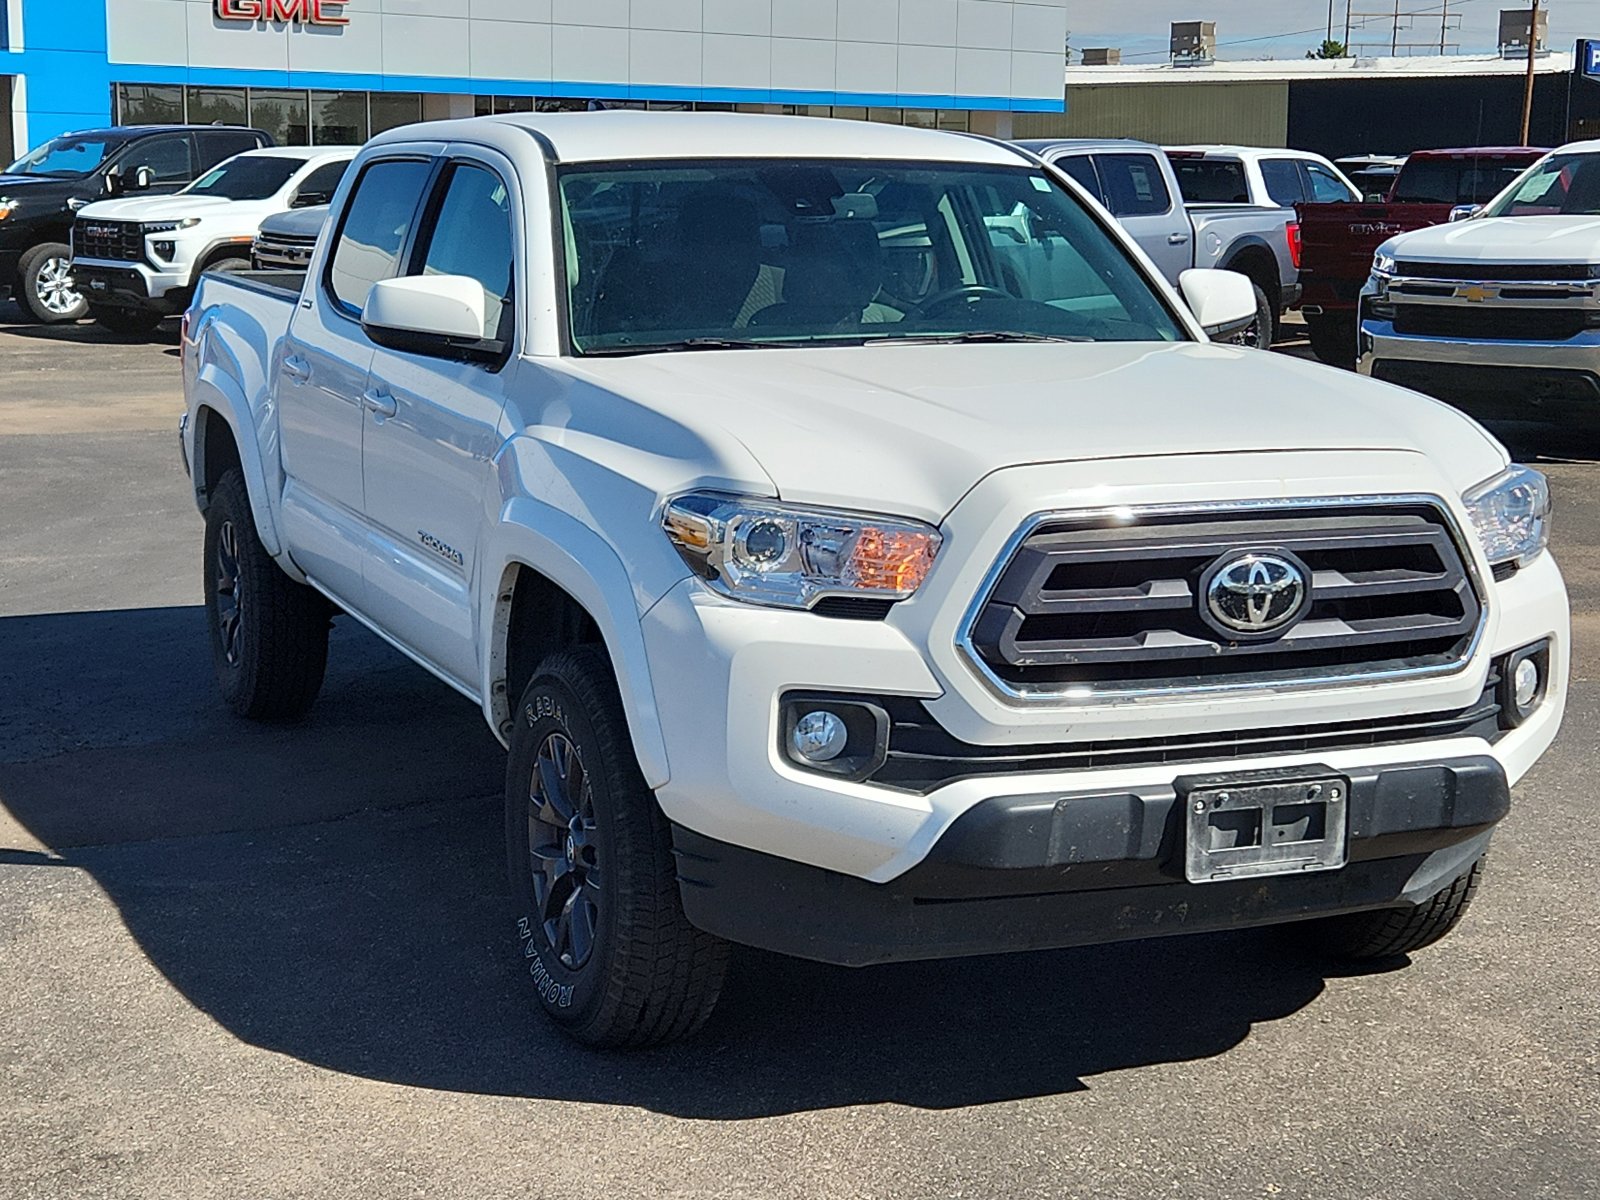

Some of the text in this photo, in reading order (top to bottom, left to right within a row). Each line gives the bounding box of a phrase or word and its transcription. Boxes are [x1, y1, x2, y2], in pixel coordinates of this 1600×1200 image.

[215, 0, 350, 26] GMC
[86, 226, 118, 238] GMC
[417, 529, 464, 566] TACOMA
